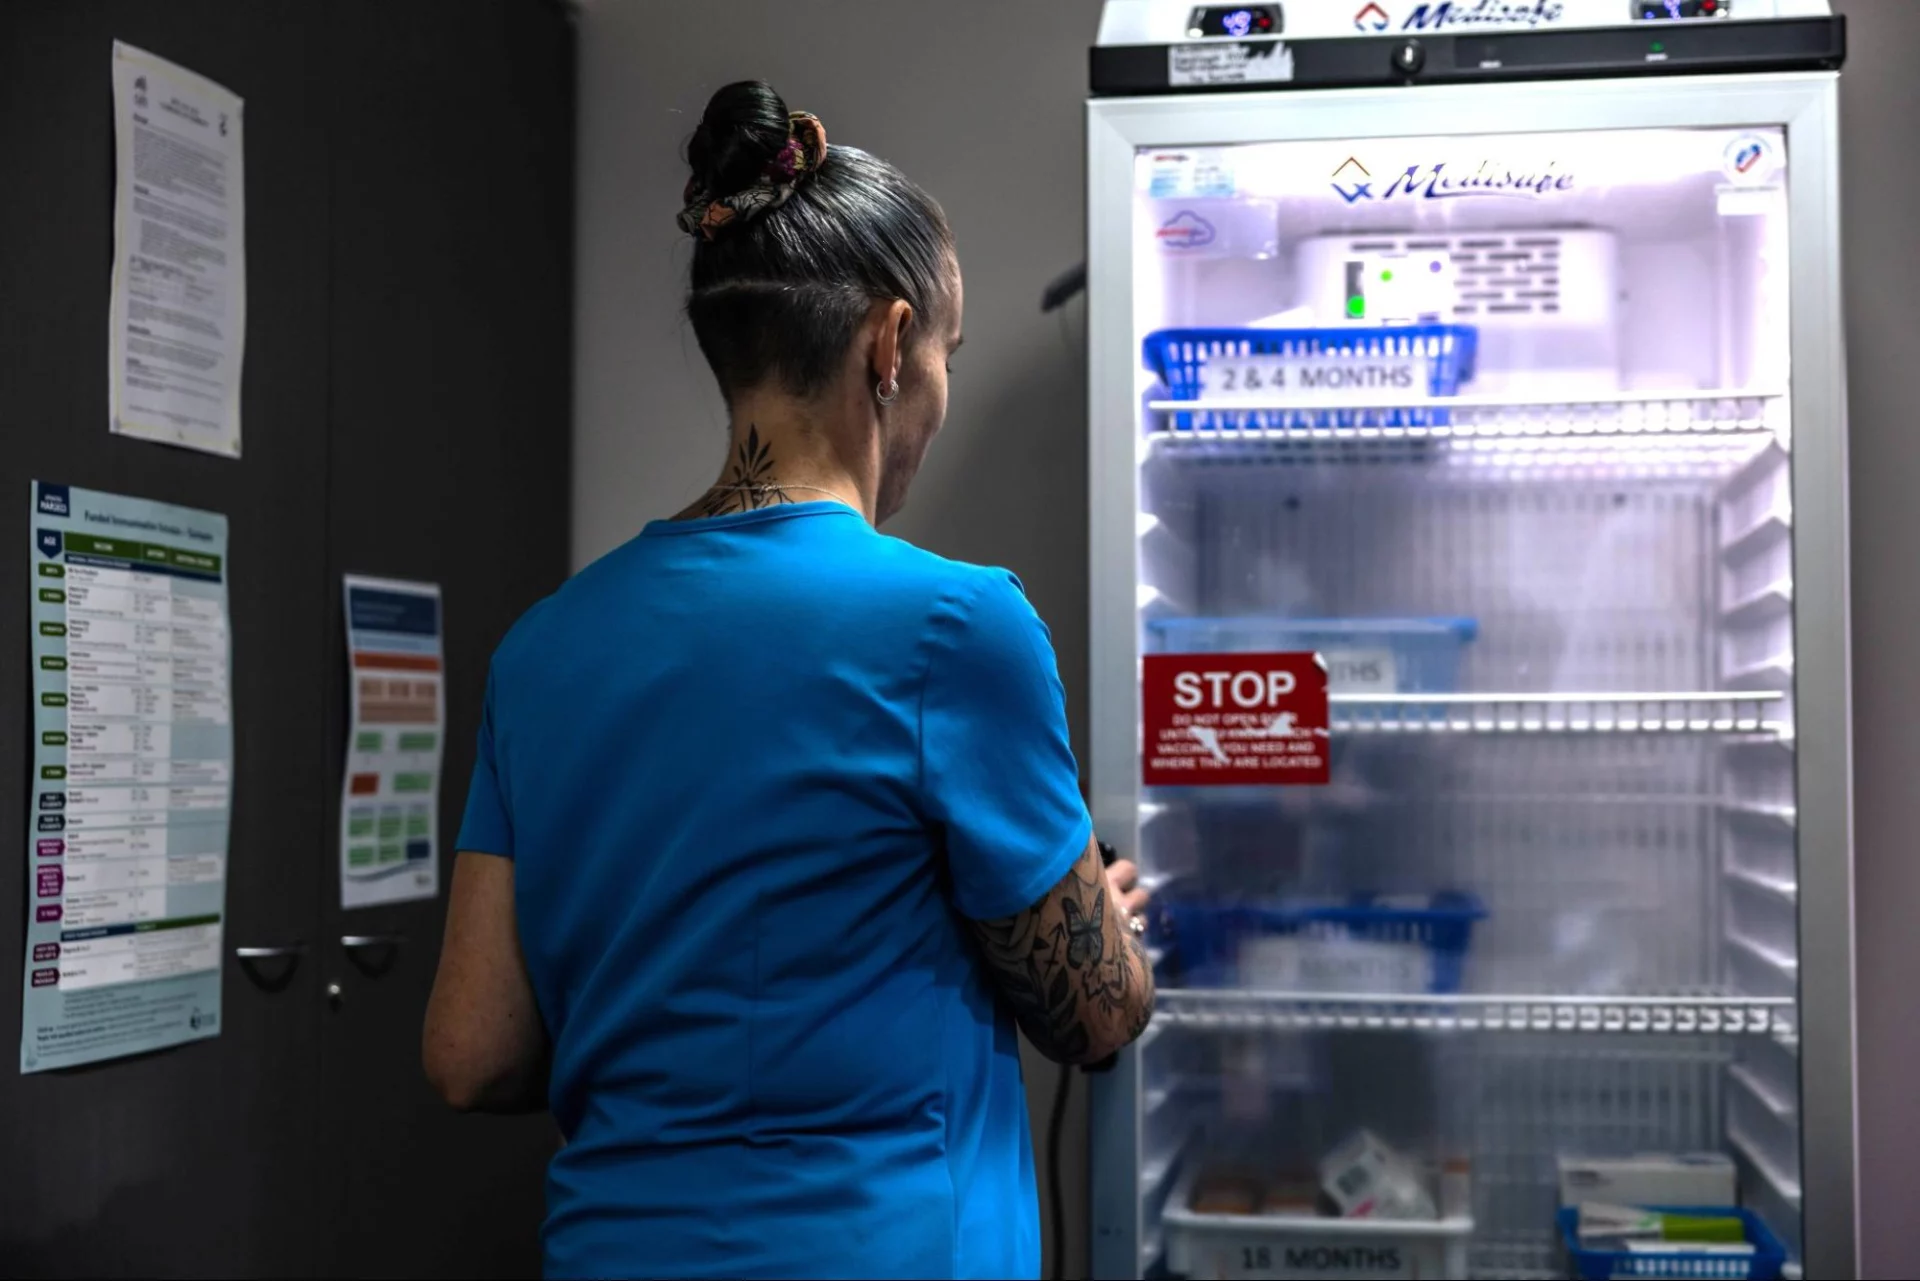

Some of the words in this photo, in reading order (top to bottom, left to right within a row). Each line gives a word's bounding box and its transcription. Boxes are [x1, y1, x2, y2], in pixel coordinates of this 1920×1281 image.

[1222, 368, 1235, 390] 2
[1243, 366, 1263, 388] &
[1269, 366, 1286, 387] 4
[1301, 365, 1413, 388] MONTHS
[1173, 670, 1297, 709] STOP
[1172, 713, 1192, 726] DO
[1194, 712, 1220, 726] NOT
[1250, 741, 1286, 754] NEED
[1288, 741, 1316, 754] AND
[1151, 757, 1196, 769] WHERE
[1233, 756, 1260, 769] ARE
[1262, 755, 1323, 769] LOCATED
[1242, 1246, 1272, 1270] 18
[1285, 1245, 1403, 1270] MONTHS
